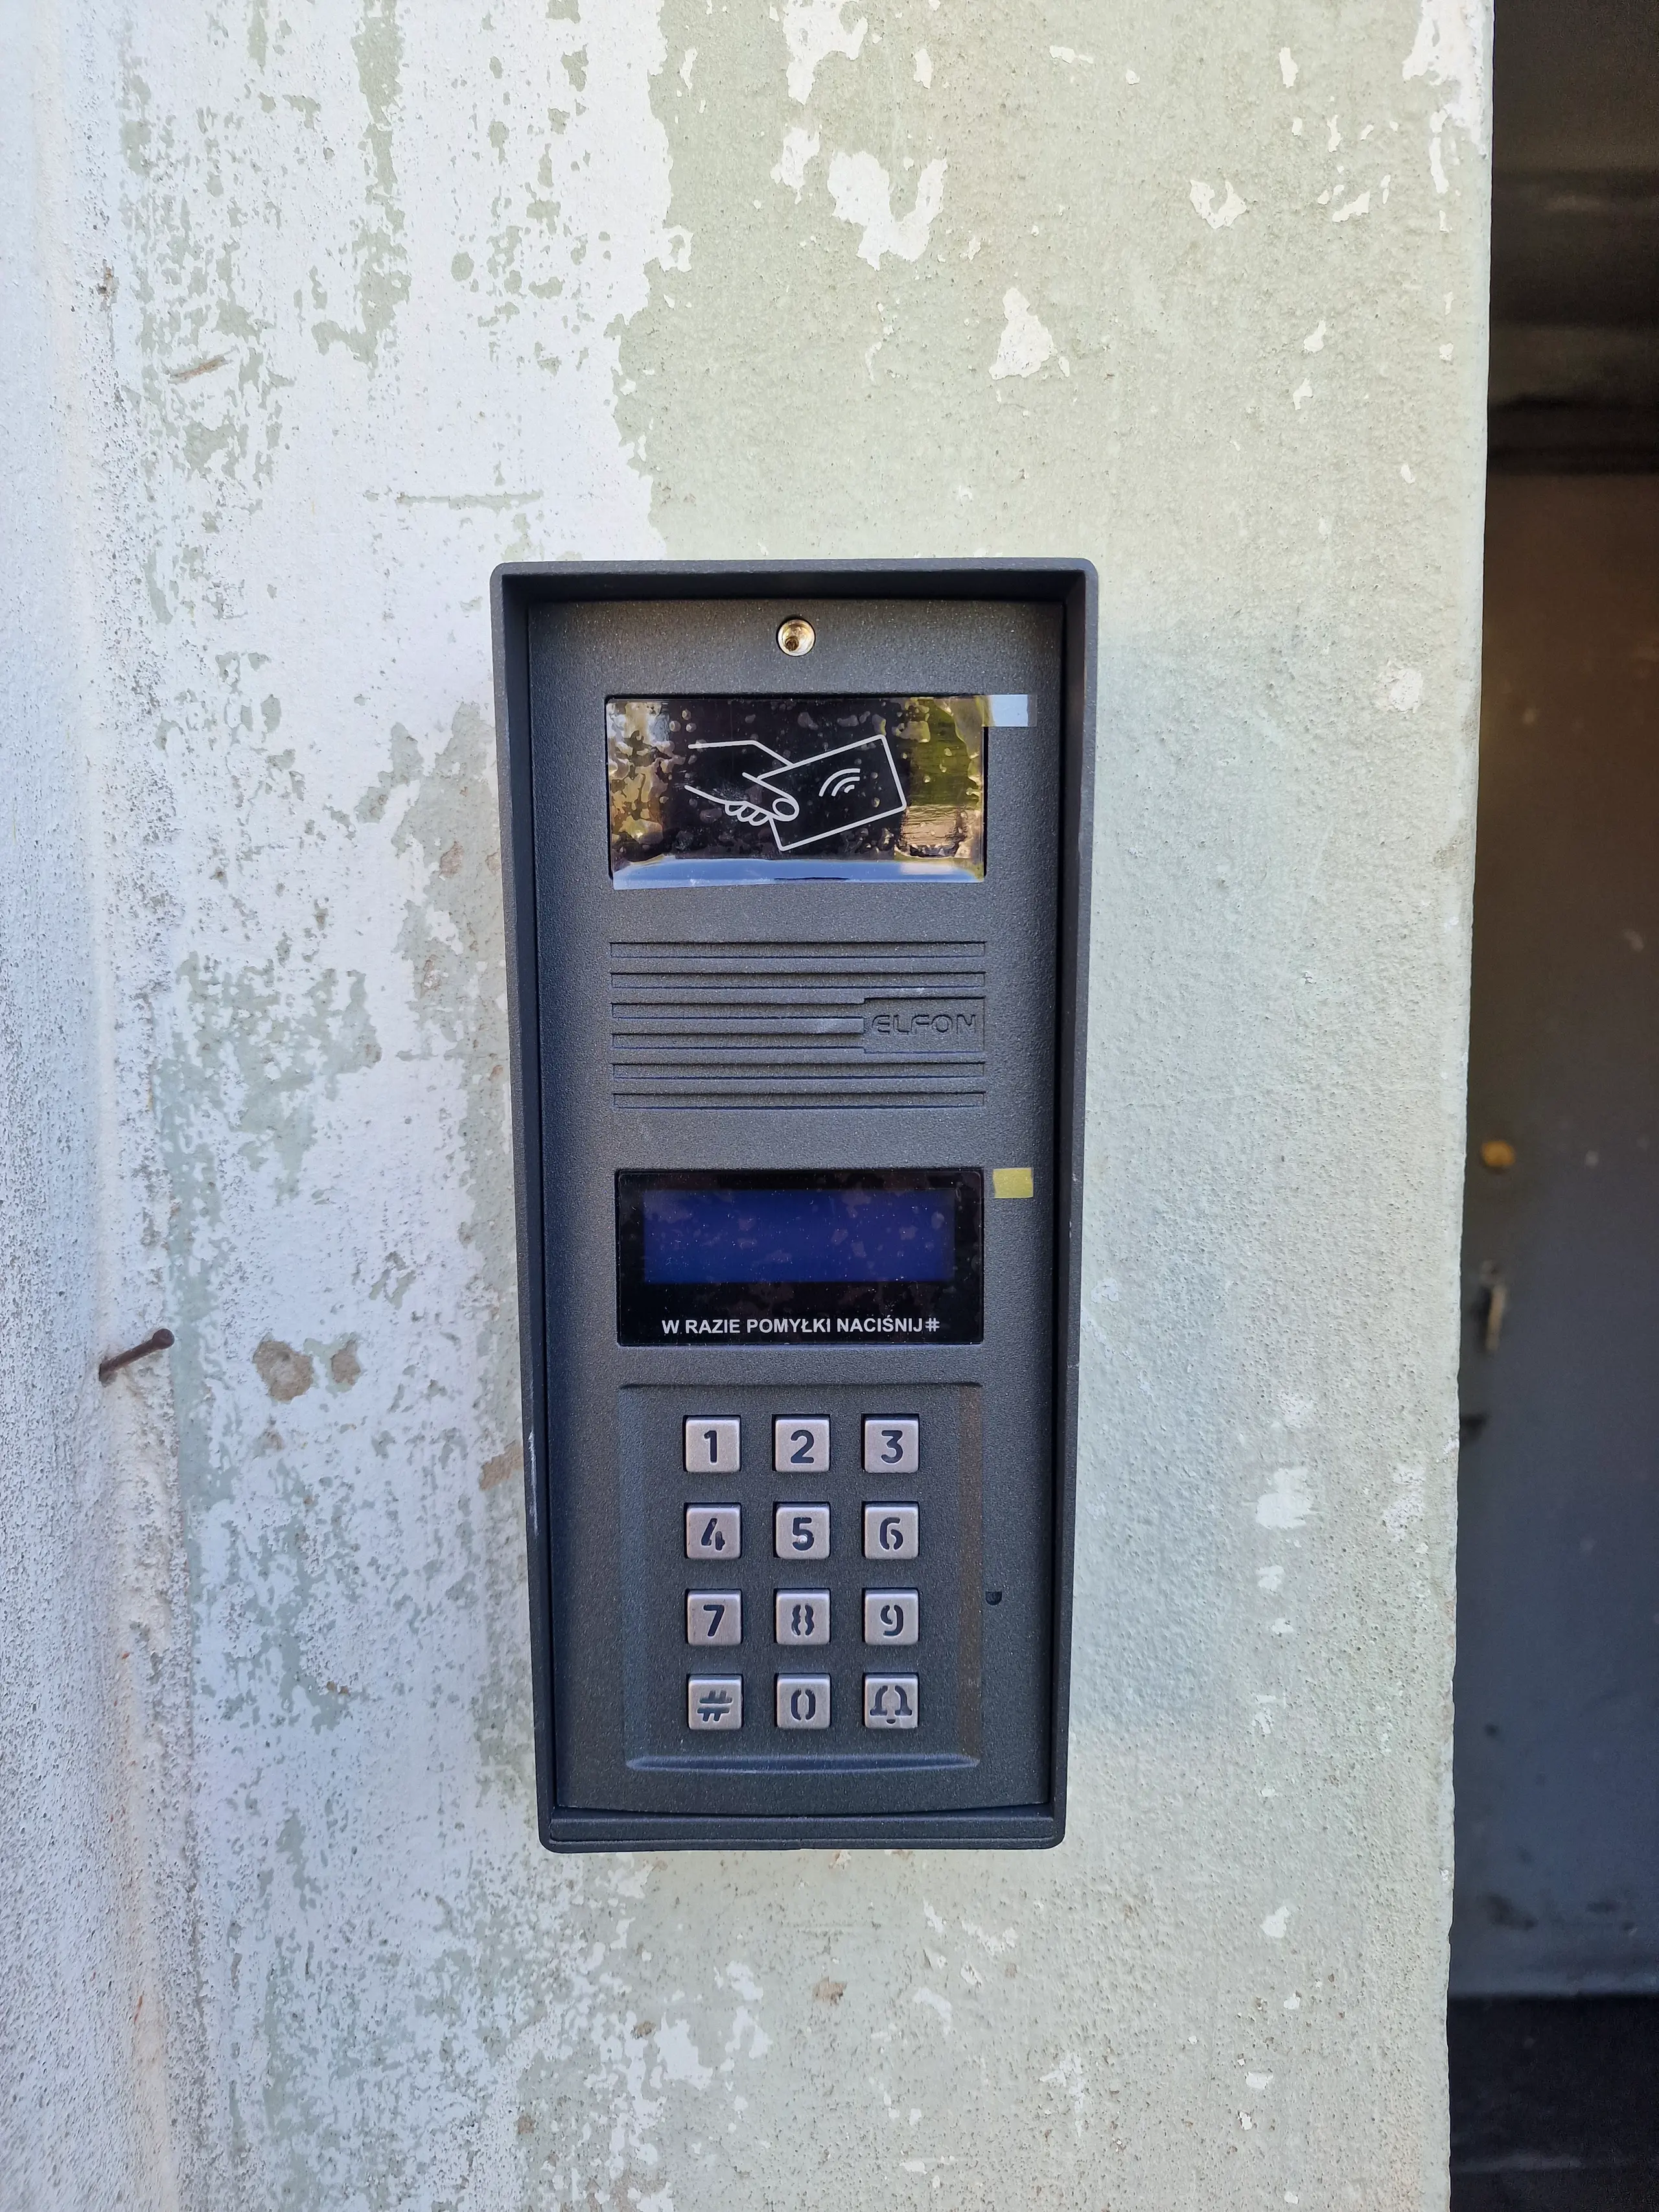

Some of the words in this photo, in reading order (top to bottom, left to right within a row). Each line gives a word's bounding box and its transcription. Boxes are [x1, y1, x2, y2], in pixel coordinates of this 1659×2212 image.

[872, 1014, 976, 1034] ELFON
[662, 1320, 679, 1334] W
[685, 1319, 740, 1333] RAZIE
[747, 1318, 831, 1333] POMYŁKI
[704, 1430, 717, 1463] 1
[790, 1429, 815, 1464] 2
[881, 1430, 903, 1464] 3
[701, 1517, 726, 1551] 4
[792, 1517, 815, 1551] 5
[879, 1517, 904, 1550] 6
[703, 1604, 725, 1637] 7
[791, 1604, 815, 1636] 8
[880, 1604, 904, 1636] 9
[791, 1688, 817, 1721] 0
